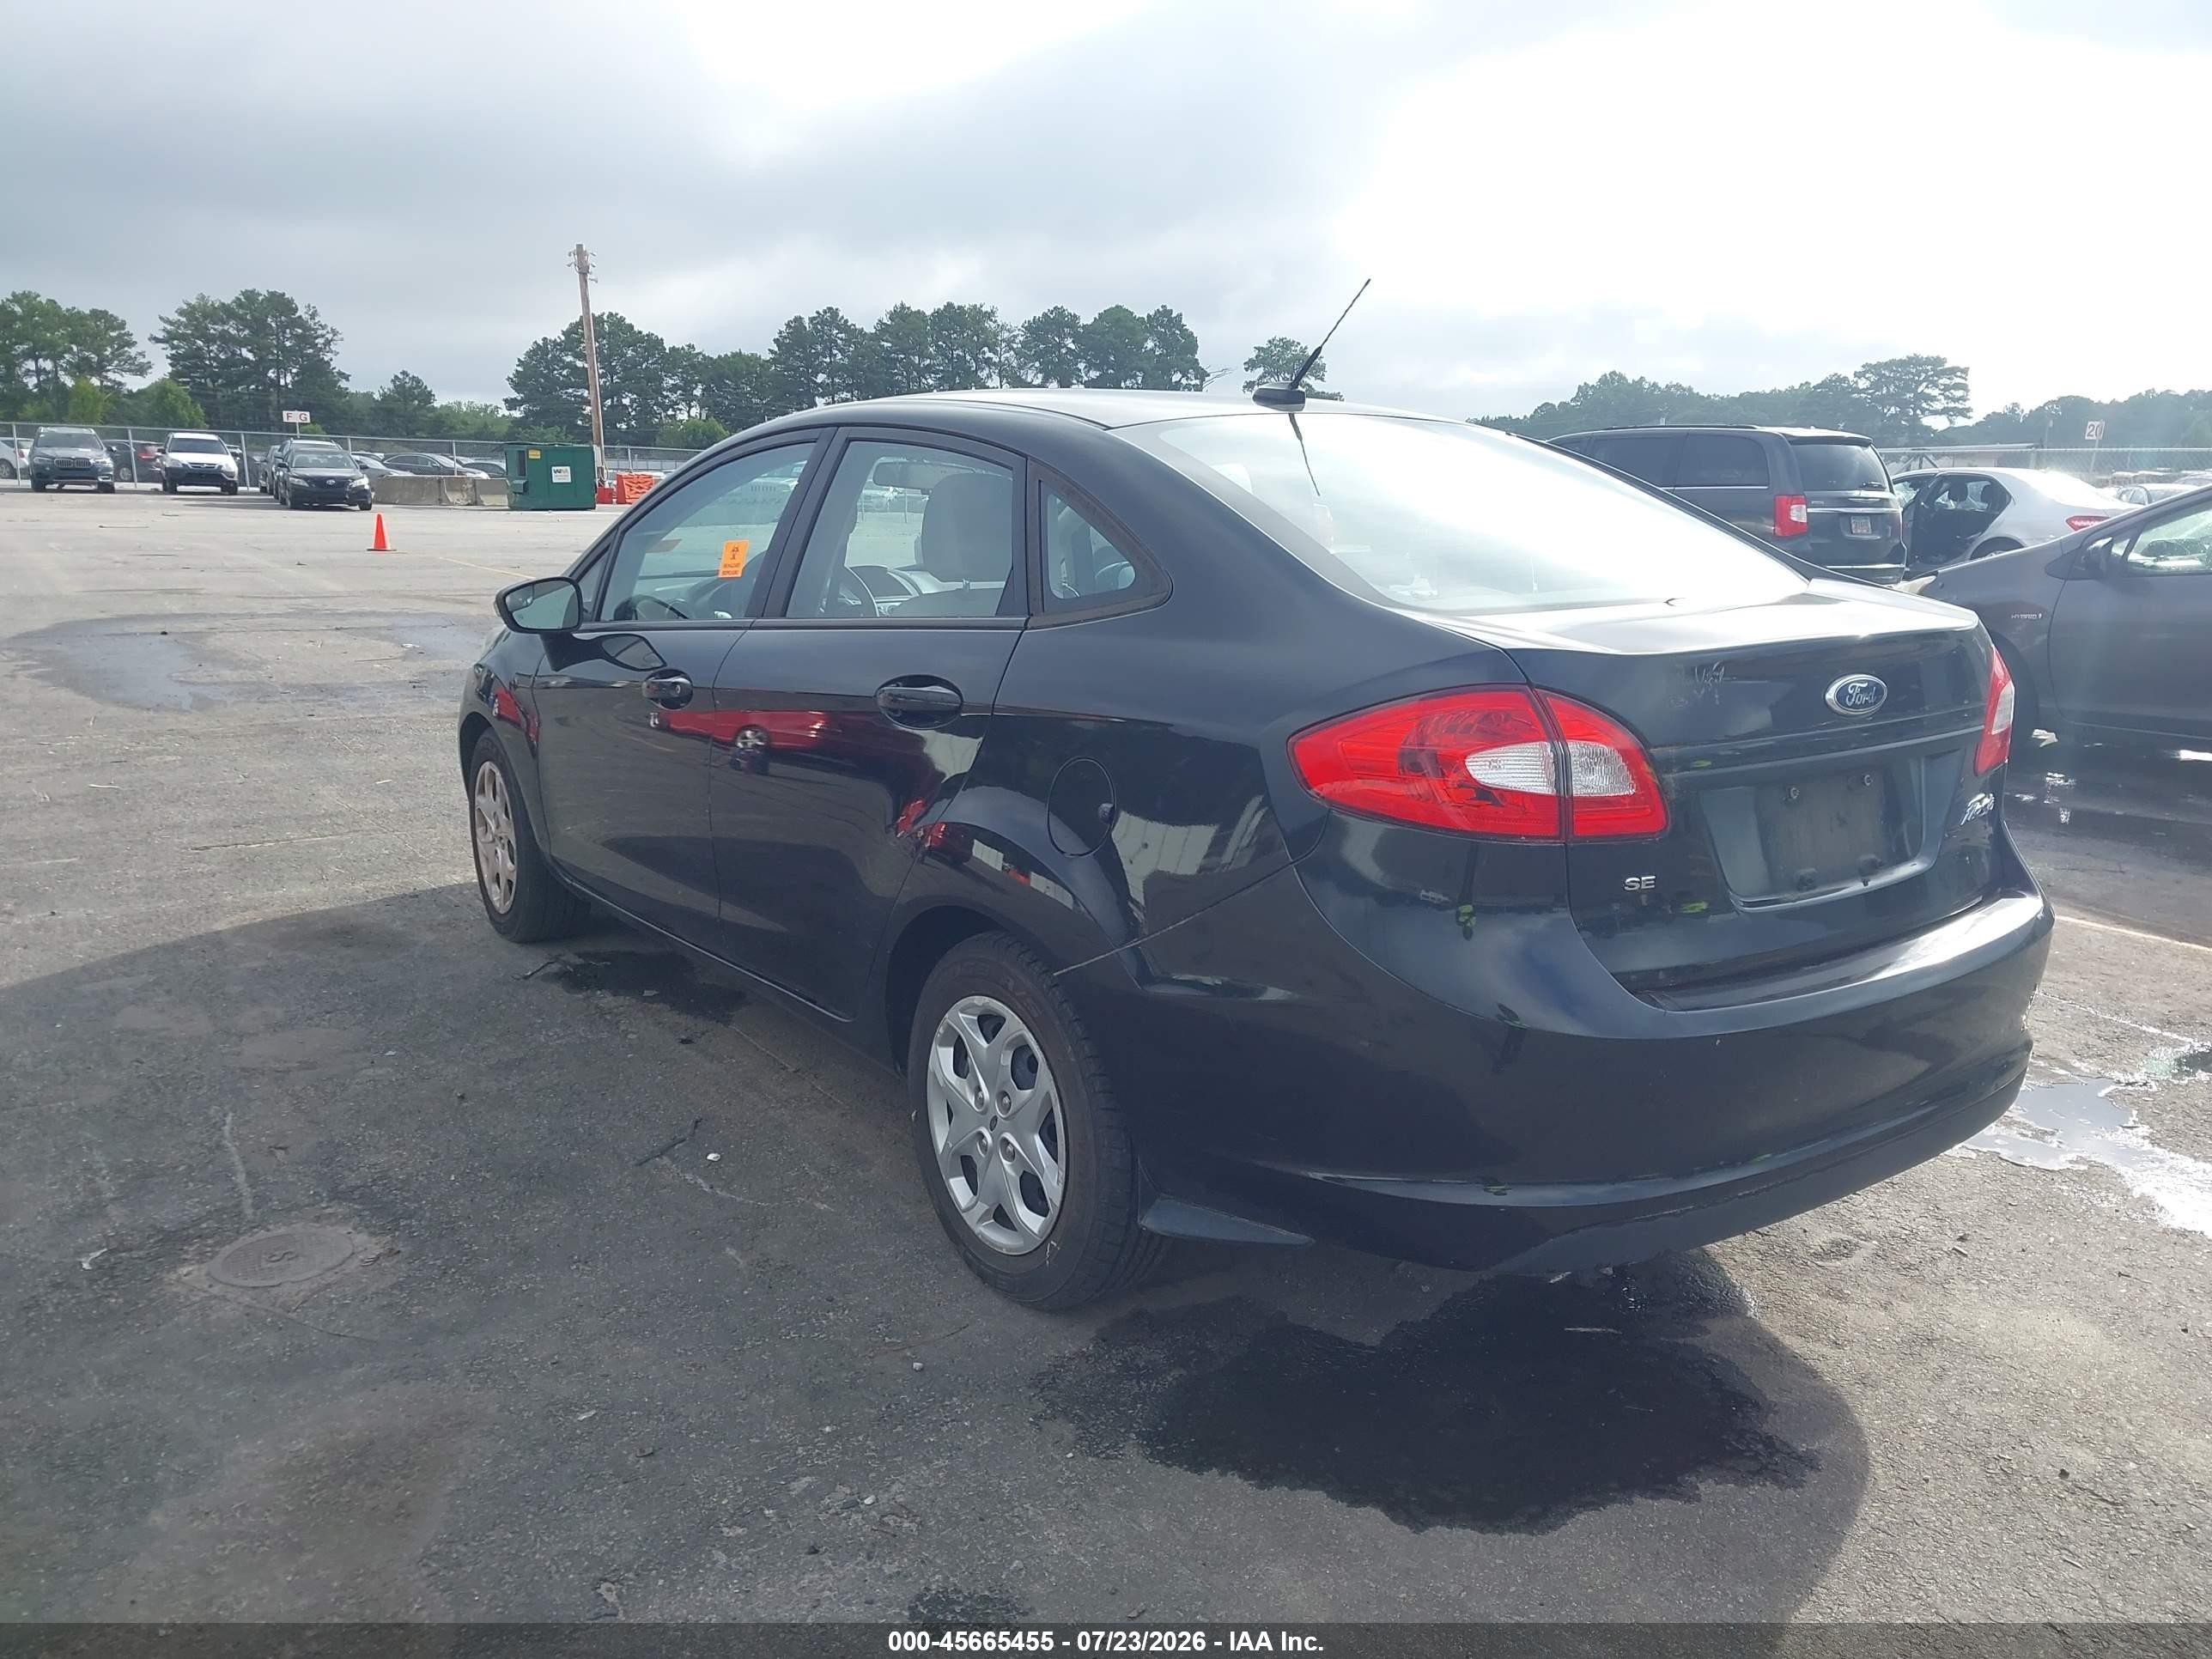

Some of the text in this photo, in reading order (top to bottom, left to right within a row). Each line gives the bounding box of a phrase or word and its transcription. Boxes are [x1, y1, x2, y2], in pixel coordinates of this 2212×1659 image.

[286, 412, 307, 422] F G
[1845, 682, 1876, 707] Ford
[1624, 875, 1656, 891] SE
